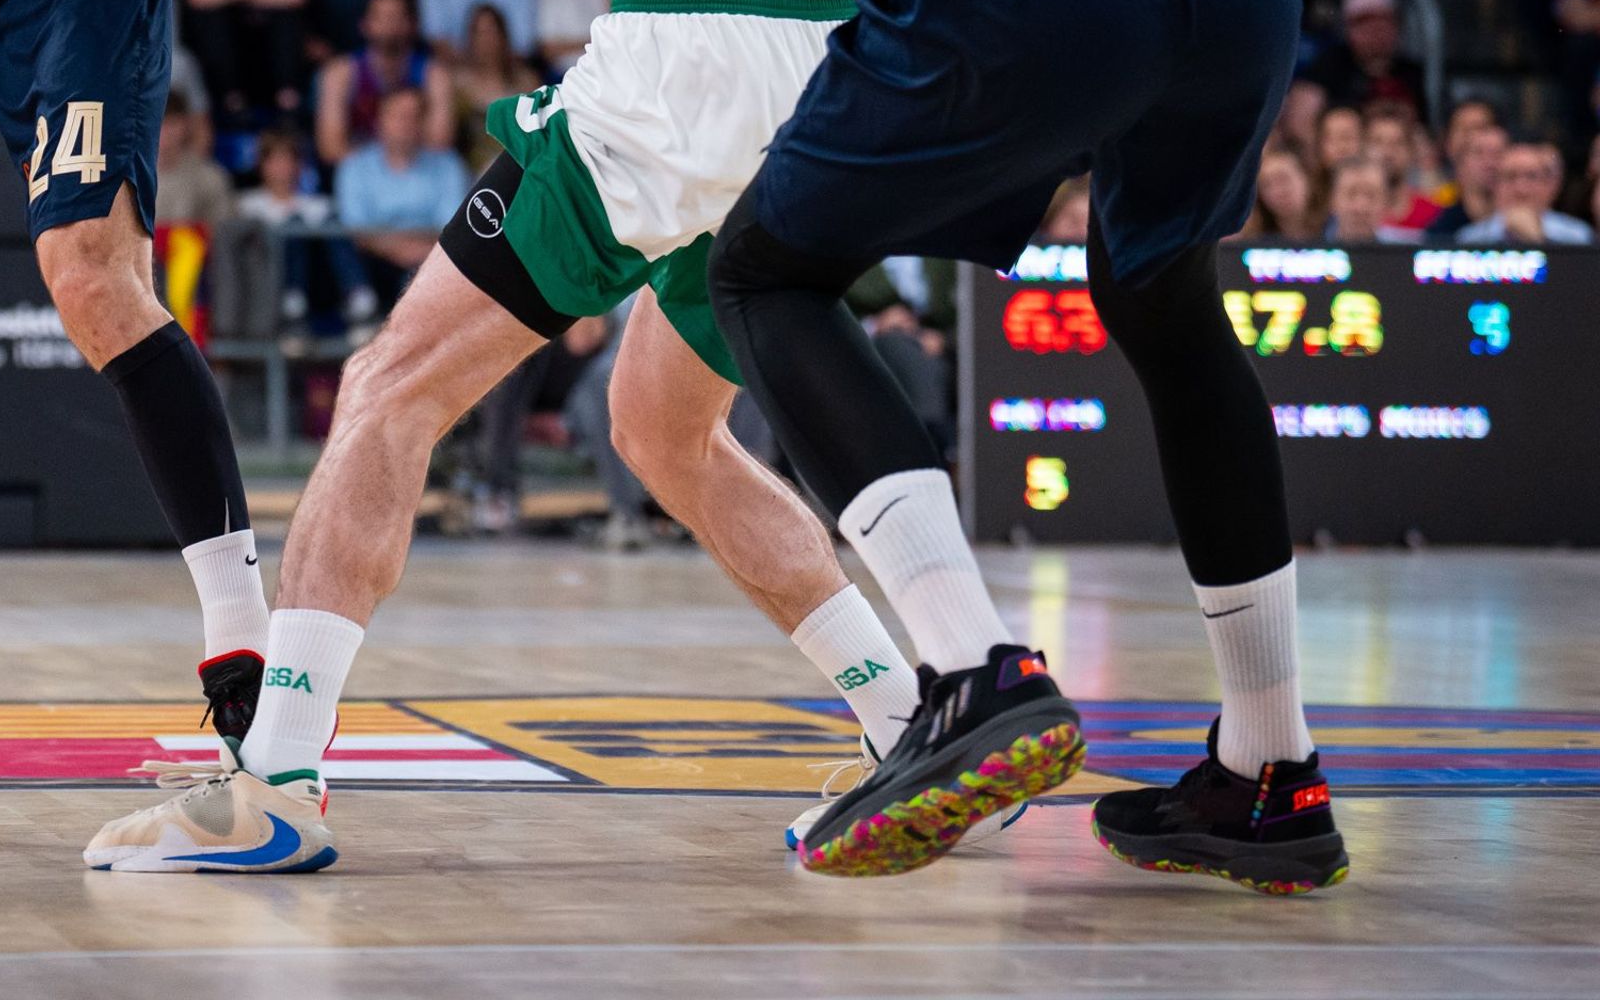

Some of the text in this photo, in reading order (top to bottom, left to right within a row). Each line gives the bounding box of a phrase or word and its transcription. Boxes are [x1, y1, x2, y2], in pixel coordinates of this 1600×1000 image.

[29, 101, 106, 205] 24
[473, 196, 500, 230] GSA
[265, 667, 313, 694] GSA
[834, 659, 890, 691] GSA
